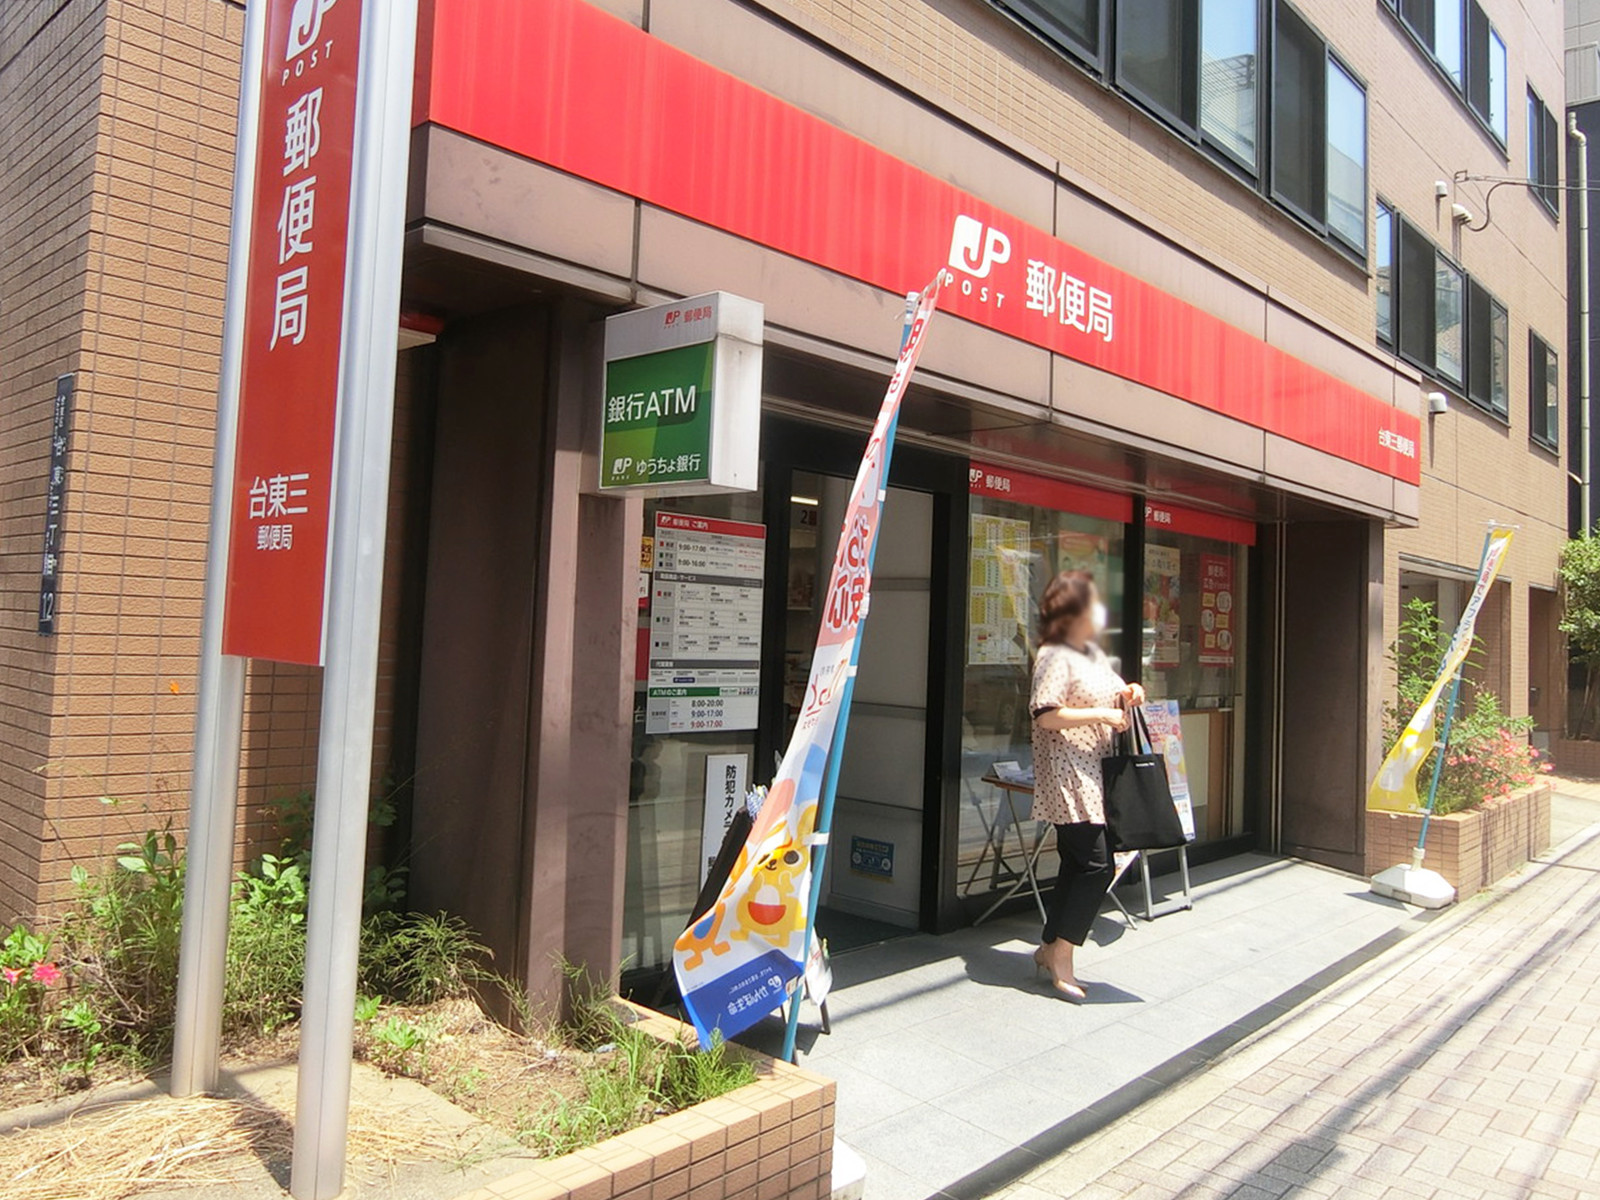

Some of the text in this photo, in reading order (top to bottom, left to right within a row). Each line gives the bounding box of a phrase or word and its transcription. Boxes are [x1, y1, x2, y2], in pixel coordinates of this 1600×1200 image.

[281, 39, 334, 86] POST
[270, 87, 323, 351] 郵便局
[944, 272, 1005, 308] POST
[948, 214, 1114, 342] JP 郵便局
[684, 306, 712, 322] 郵便局
[608, 385, 697, 423] 銀行ATM
[636, 453, 701, 475] ゆうちょ銀行
[249, 473, 310, 519] 台東三
[986, 475, 1011, 493] 郵便局
[257, 525, 293, 550] 郵便局
[43, 592, 54, 619] 12
[691, 699, 724, 708] 8:00-20:00
[691, 709, 724, 718] 9:00-17:00
[690, 719, 723, 729] 9:00-17:00
